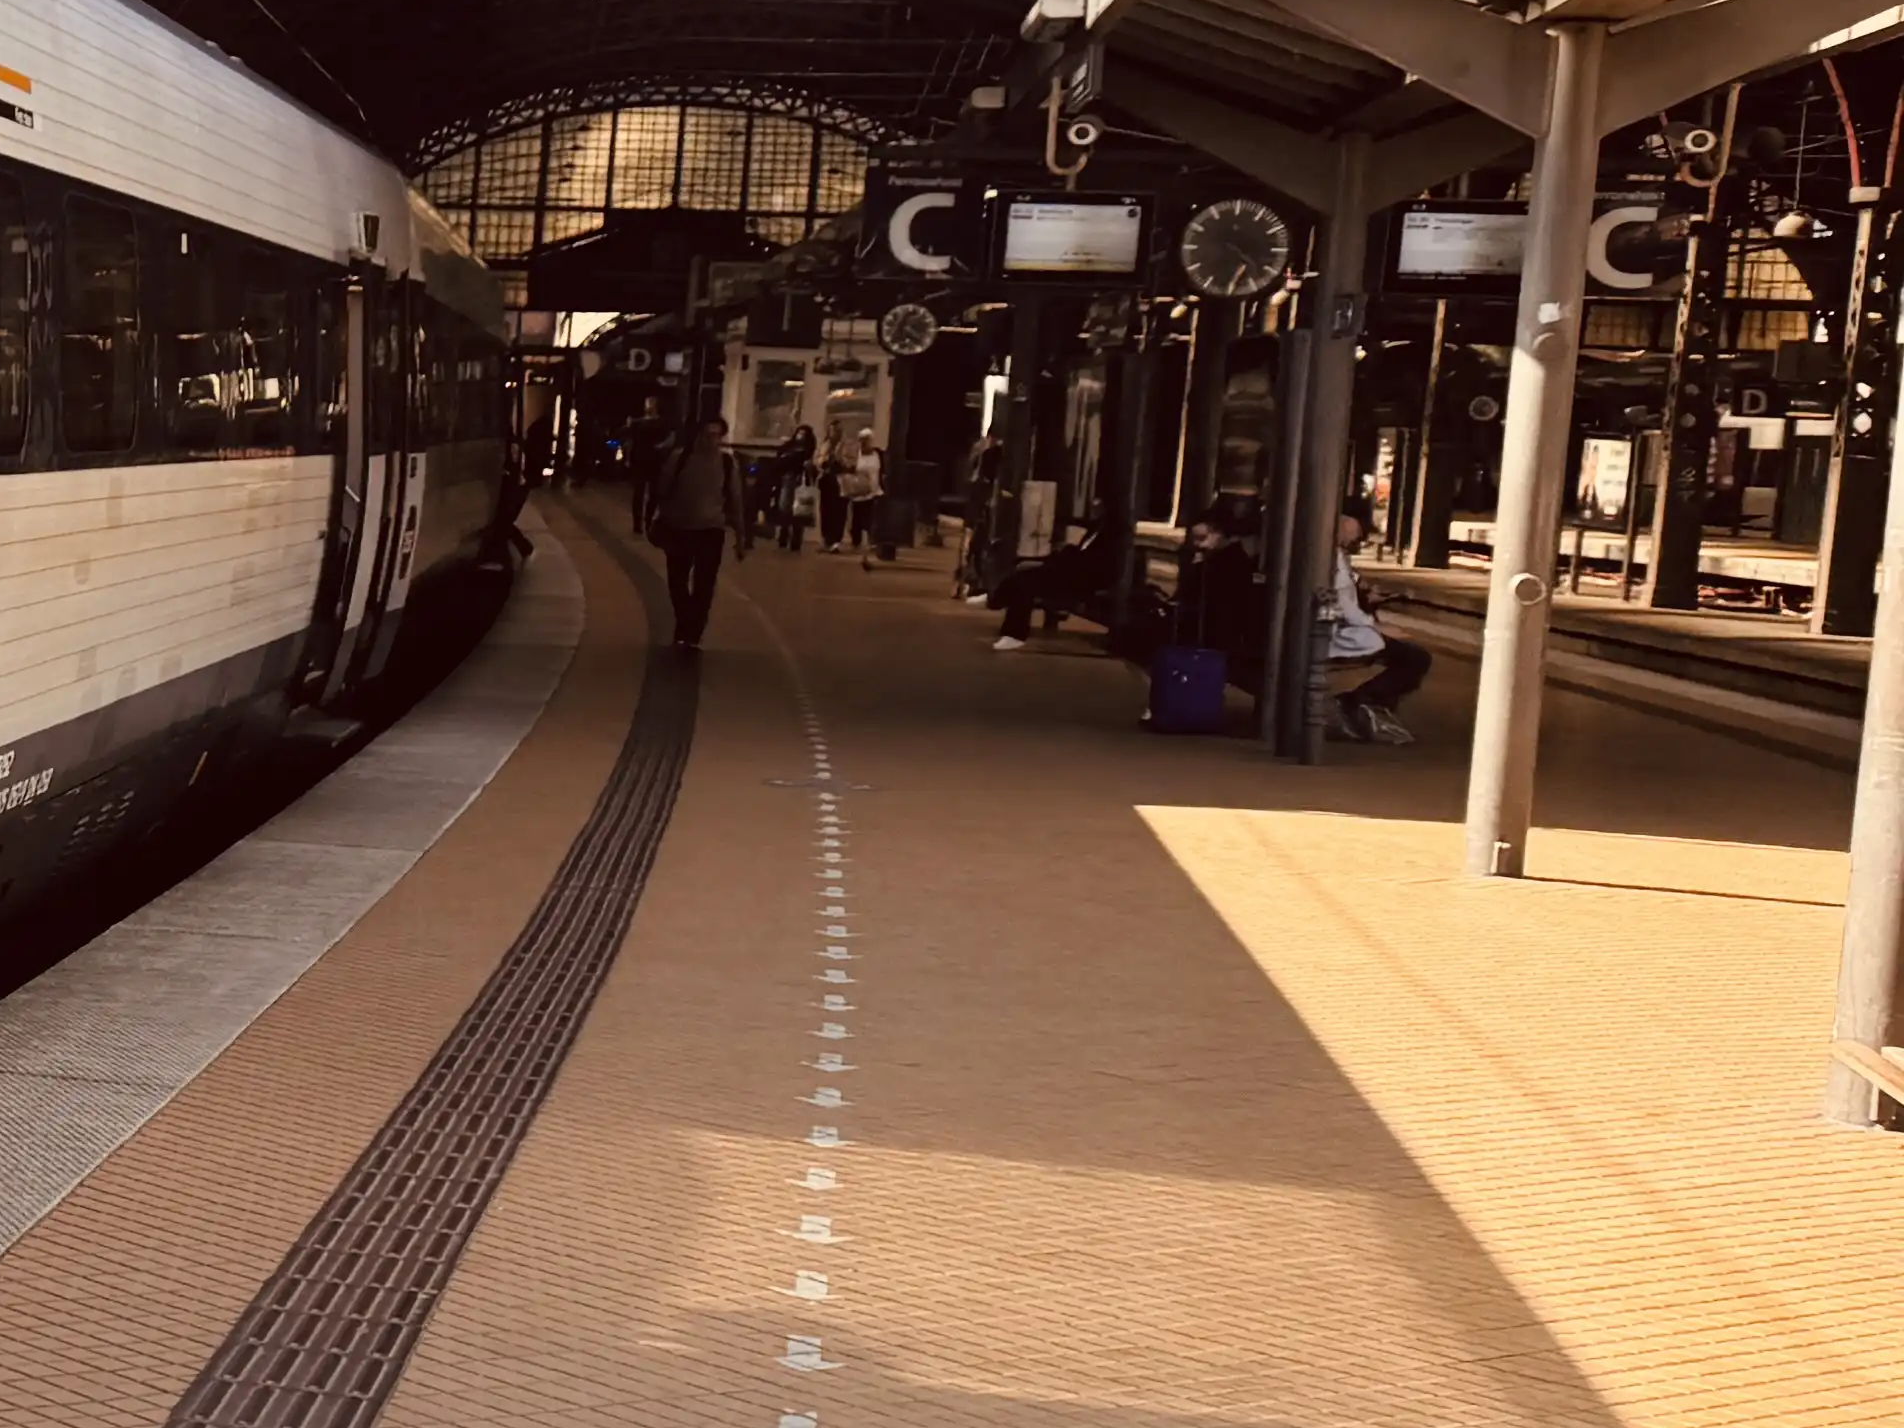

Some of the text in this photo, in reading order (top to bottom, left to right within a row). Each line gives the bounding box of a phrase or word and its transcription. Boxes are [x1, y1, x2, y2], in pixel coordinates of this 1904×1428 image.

[888, 192, 956, 271] C
[1587, 206, 1659, 289] C
[1741, 389, 1768, 414] D
